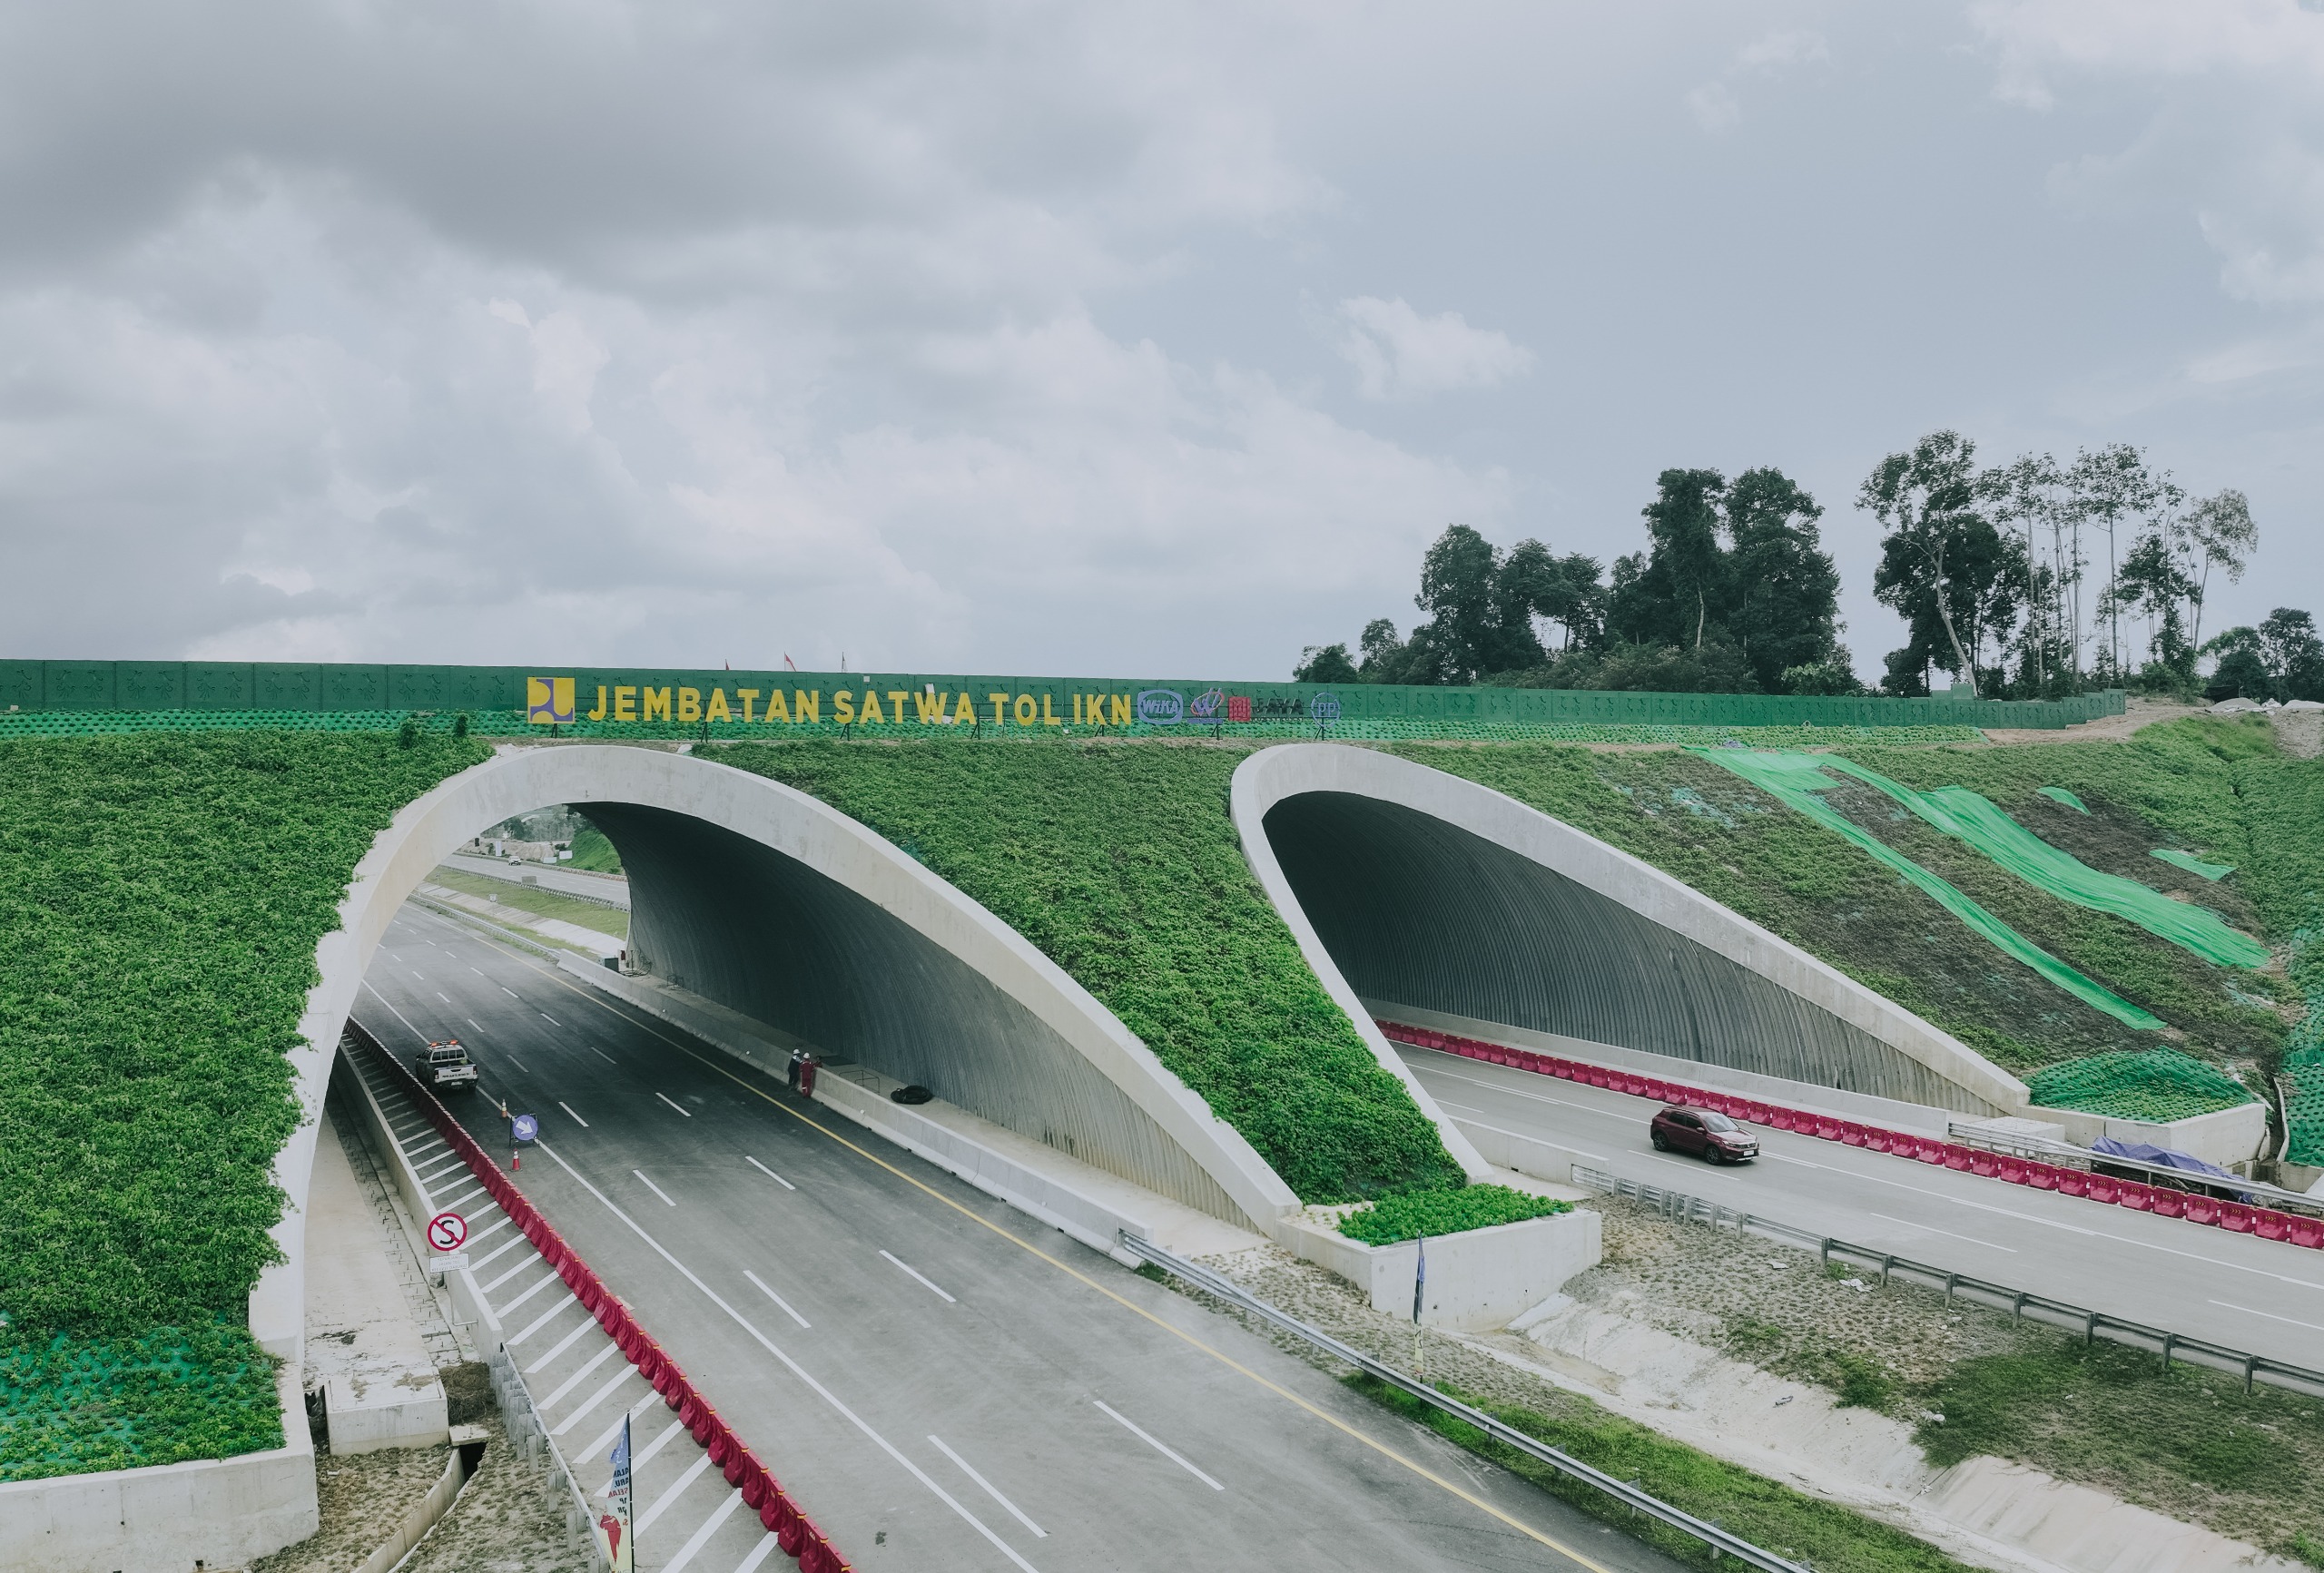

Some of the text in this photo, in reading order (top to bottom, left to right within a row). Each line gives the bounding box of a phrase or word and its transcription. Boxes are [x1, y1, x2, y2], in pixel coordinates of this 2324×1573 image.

[587, 685, 1132, 725] JEMBATAN SATWA TOL IKN
